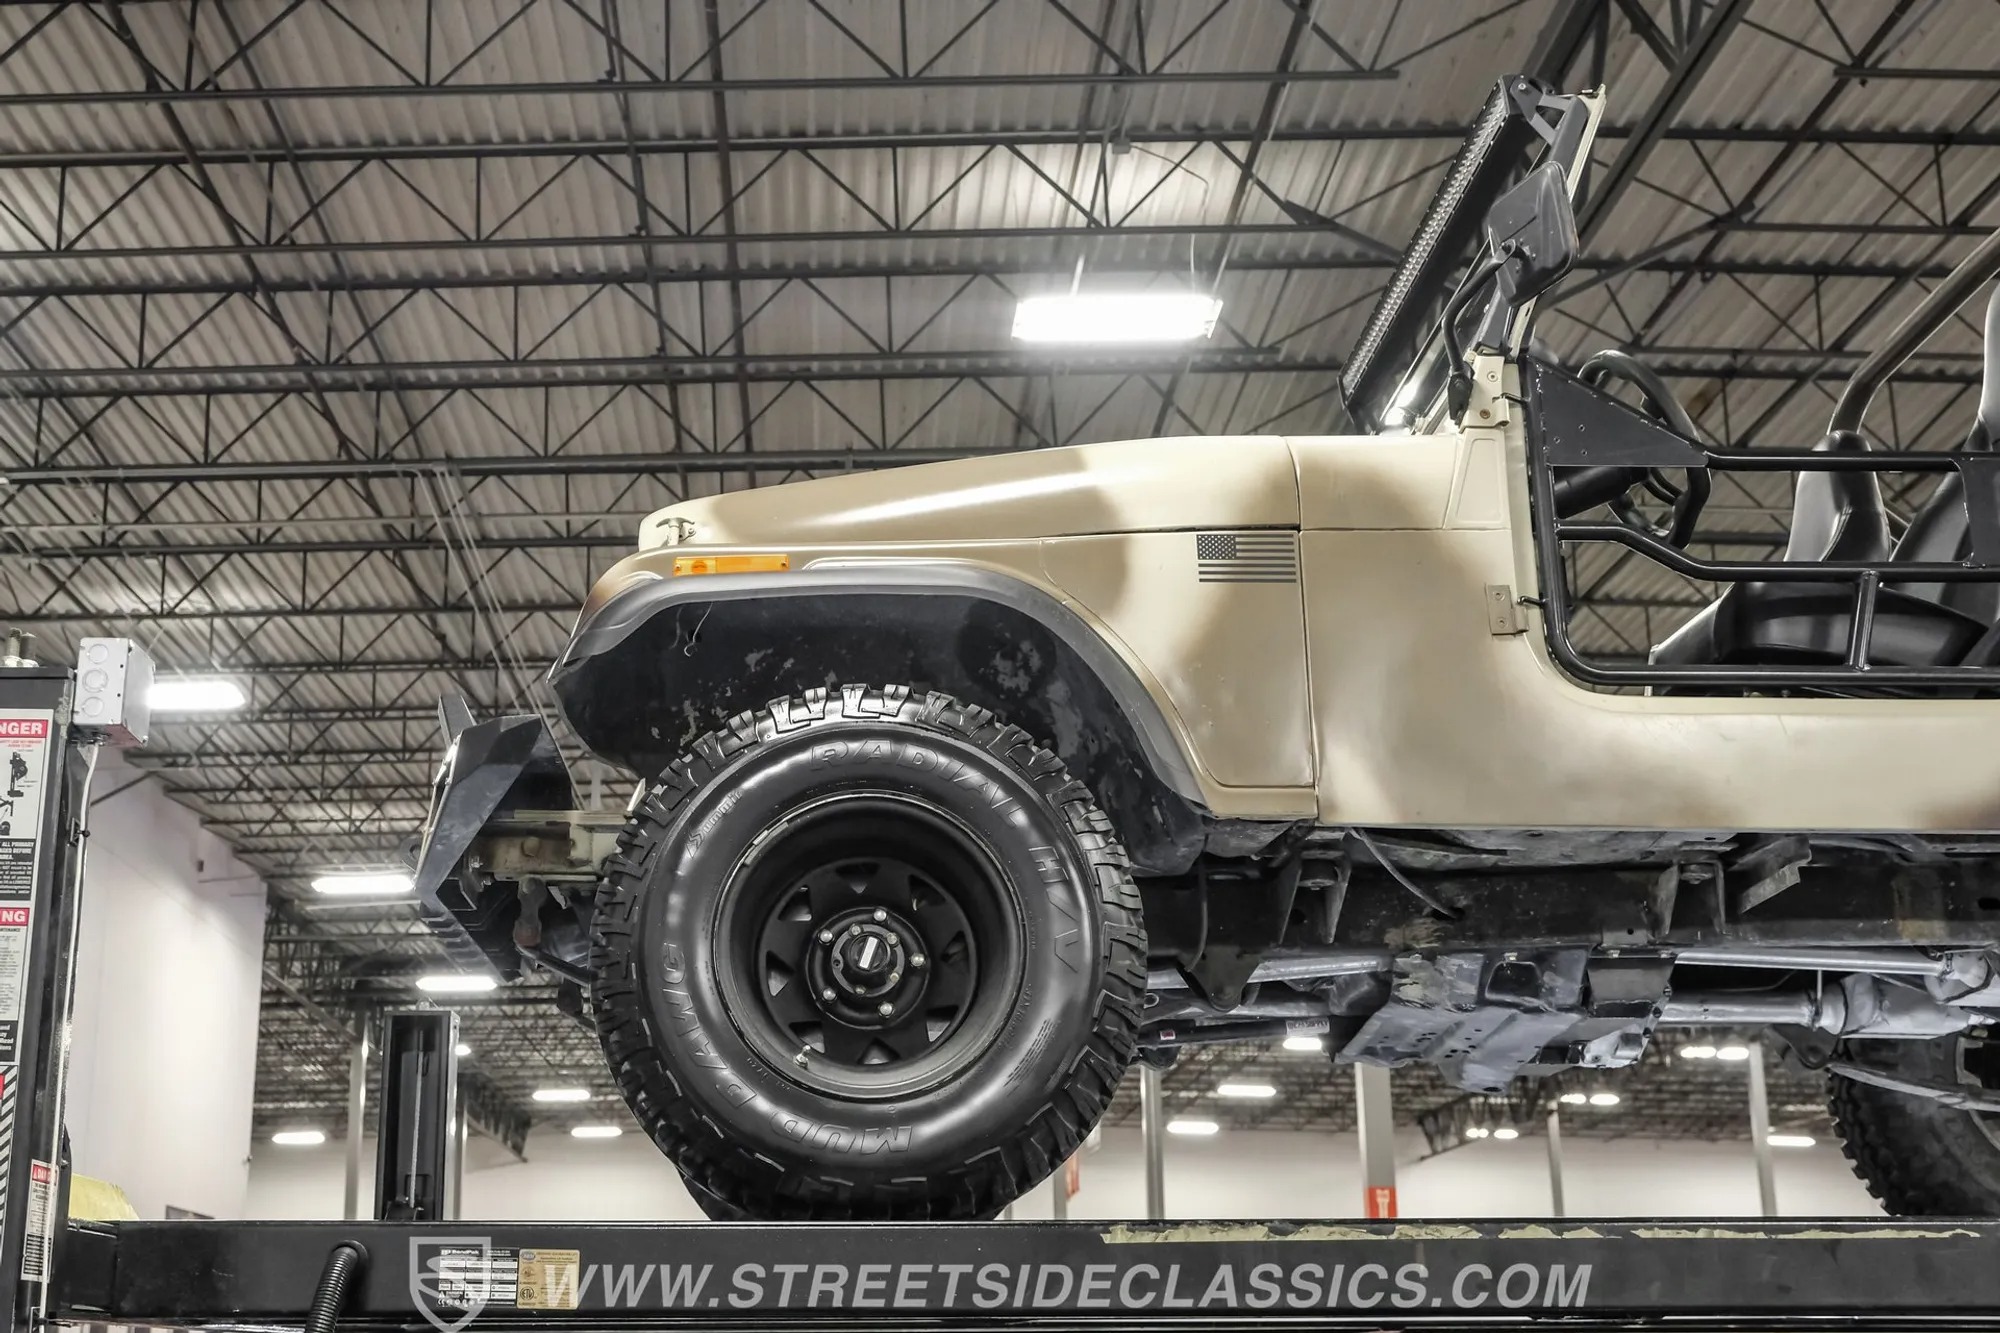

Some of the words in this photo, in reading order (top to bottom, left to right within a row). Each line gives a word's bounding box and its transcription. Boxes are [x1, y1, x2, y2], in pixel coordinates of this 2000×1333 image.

[810, 739, 1026, 827] RADIAL
[660, 941, 757, 1109] DAWG
[769, 1111, 914, 1156] MUD
